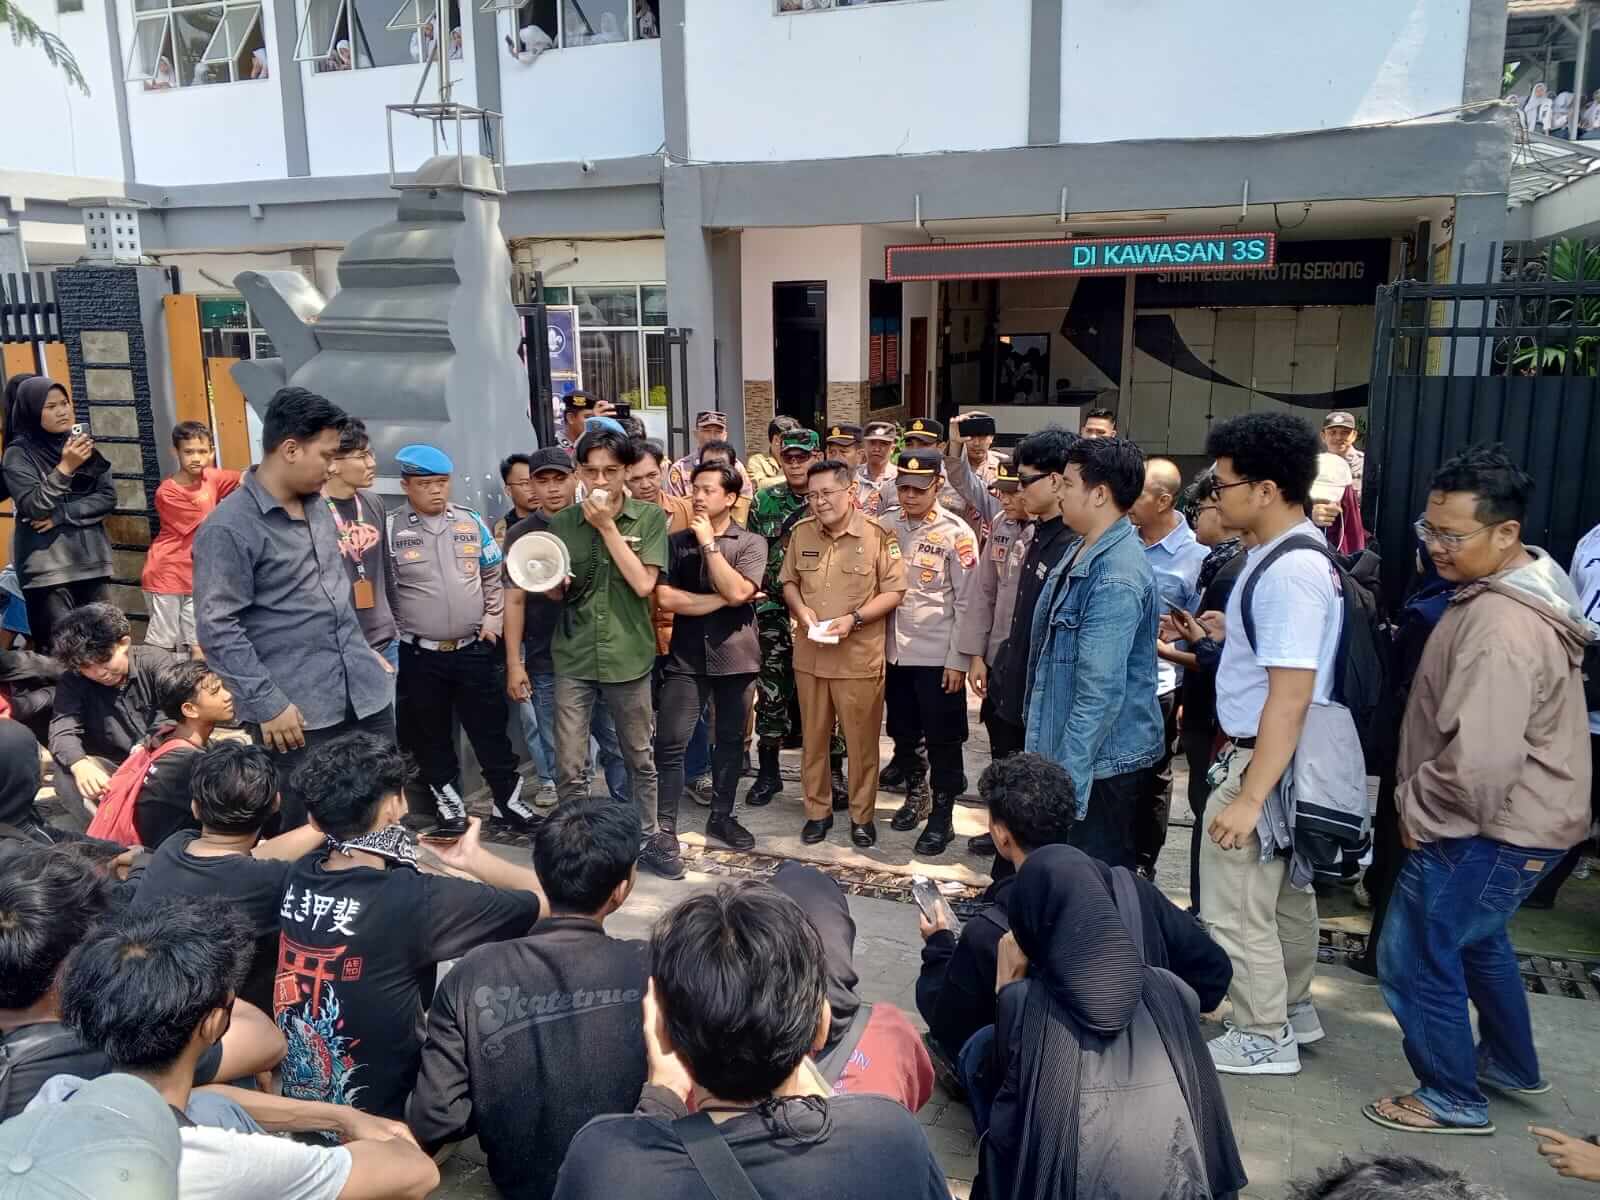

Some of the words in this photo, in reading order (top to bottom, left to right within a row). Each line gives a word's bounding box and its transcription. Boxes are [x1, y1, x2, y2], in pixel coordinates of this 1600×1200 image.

[1073, 246, 1096, 266] DI
[1104, 242, 1225, 265] KAWASAN
[1232, 240, 1265, 260] 3S
[1303, 261, 1365, 280] SERANG
[454, 534, 478, 543] POLRI
[918, 543, 945, 557] POLRI
[474, 985, 641, 1035] Skatetrue
